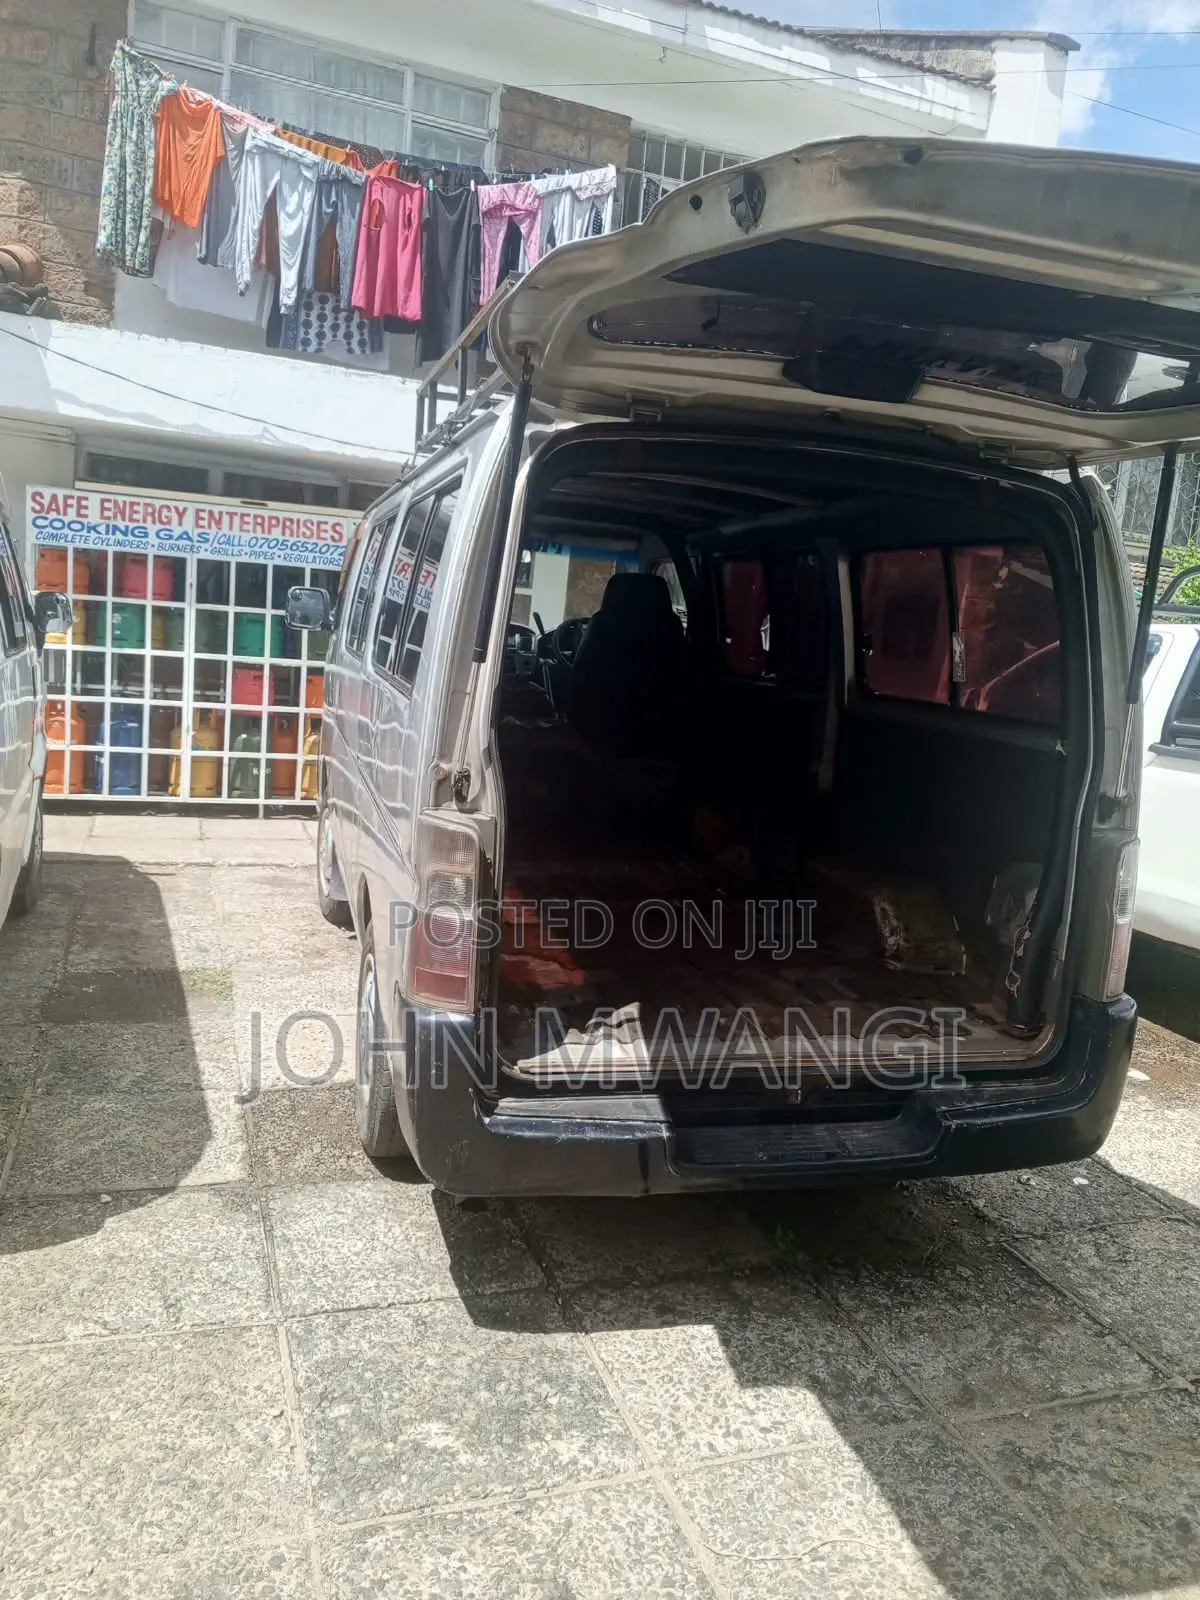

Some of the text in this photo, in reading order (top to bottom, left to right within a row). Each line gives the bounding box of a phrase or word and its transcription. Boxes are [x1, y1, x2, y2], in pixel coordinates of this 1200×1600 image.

[30, 491, 344, 543] SAFE ENERGY ENTERPRISES
[32, 516, 149, 538] COOKING
[35, 530, 342, 567] COMPLETE CYLINDERS BURNERS GRILLS PIPES REGULATORS
